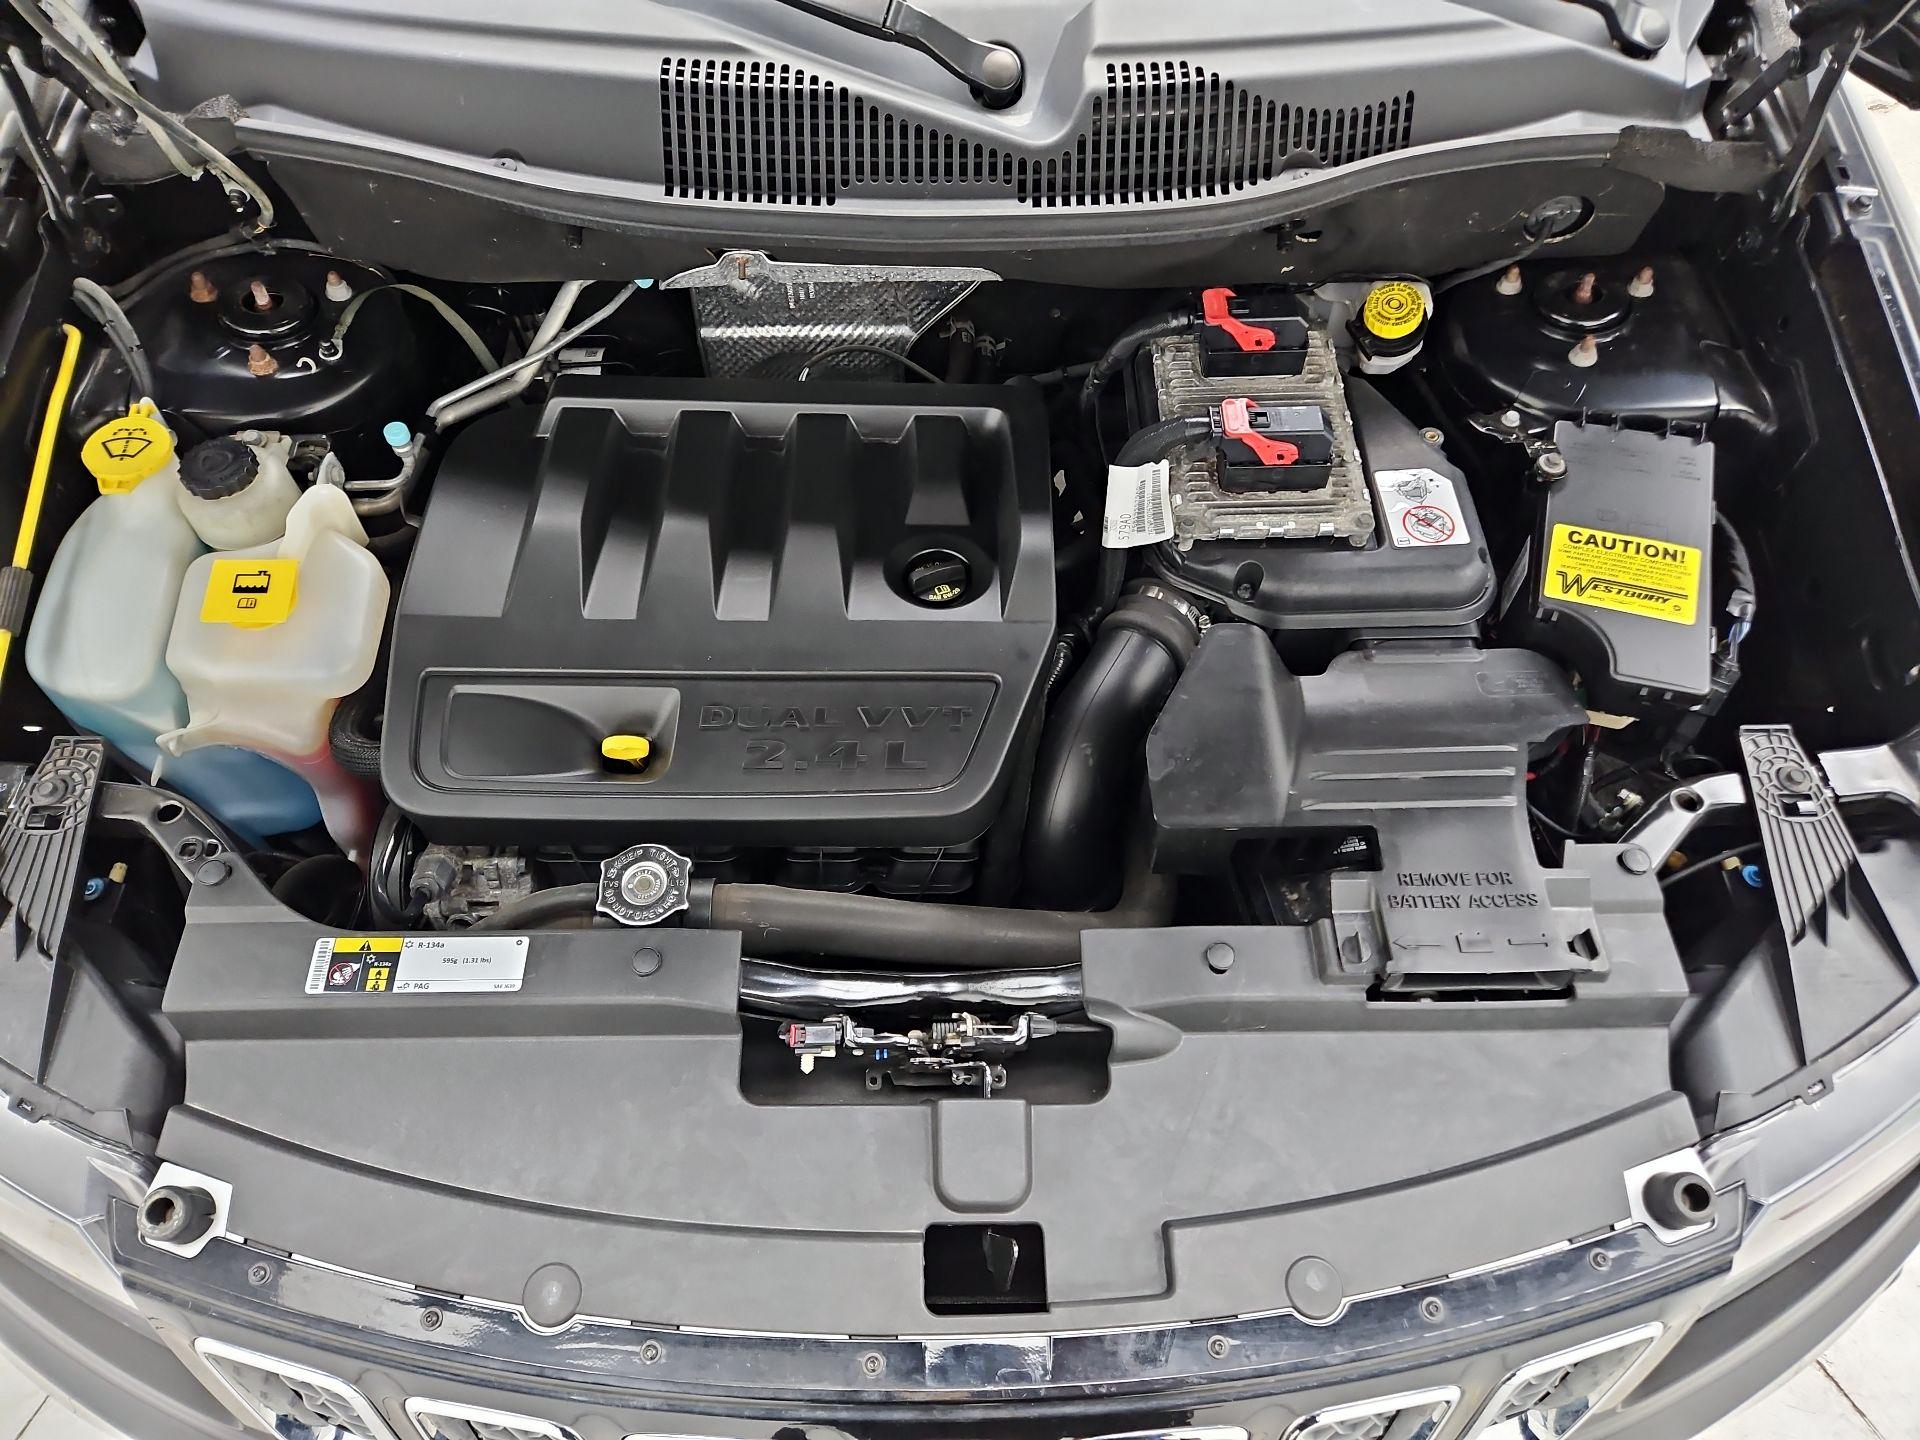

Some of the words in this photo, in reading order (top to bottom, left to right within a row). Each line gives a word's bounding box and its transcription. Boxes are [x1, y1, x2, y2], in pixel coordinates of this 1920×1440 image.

[1562, 542, 1594, 553] COMPLEX
[1595, 549, 1637, 561] ELECTRONIC
[1639, 557, 1687, 570] COMPONENTS
[1567, 529, 1686, 564] CAUTION!
[1556, 571, 1671, 604] WESTBURY
[700, 705, 845, 729] DUAL
[857, 705, 973, 729] VVT
[615, 849, 643, 868] KEEP
[650, 848, 678, 868] TIGHT
[1396, 872, 1471, 887] REMOVE
[1475, 871, 1513, 886] FOR
[612, 902, 634, 918] NOT
[634, 906, 664, 920] OPEN
[1387, 894, 1461, 909] BATTERY
[1469, 893, 1538, 908] ACCESS
[442, 957, 458, 965] 595g
[462, 957, 479, 965] (1.31
[480, 956, 492, 964] lbs)
